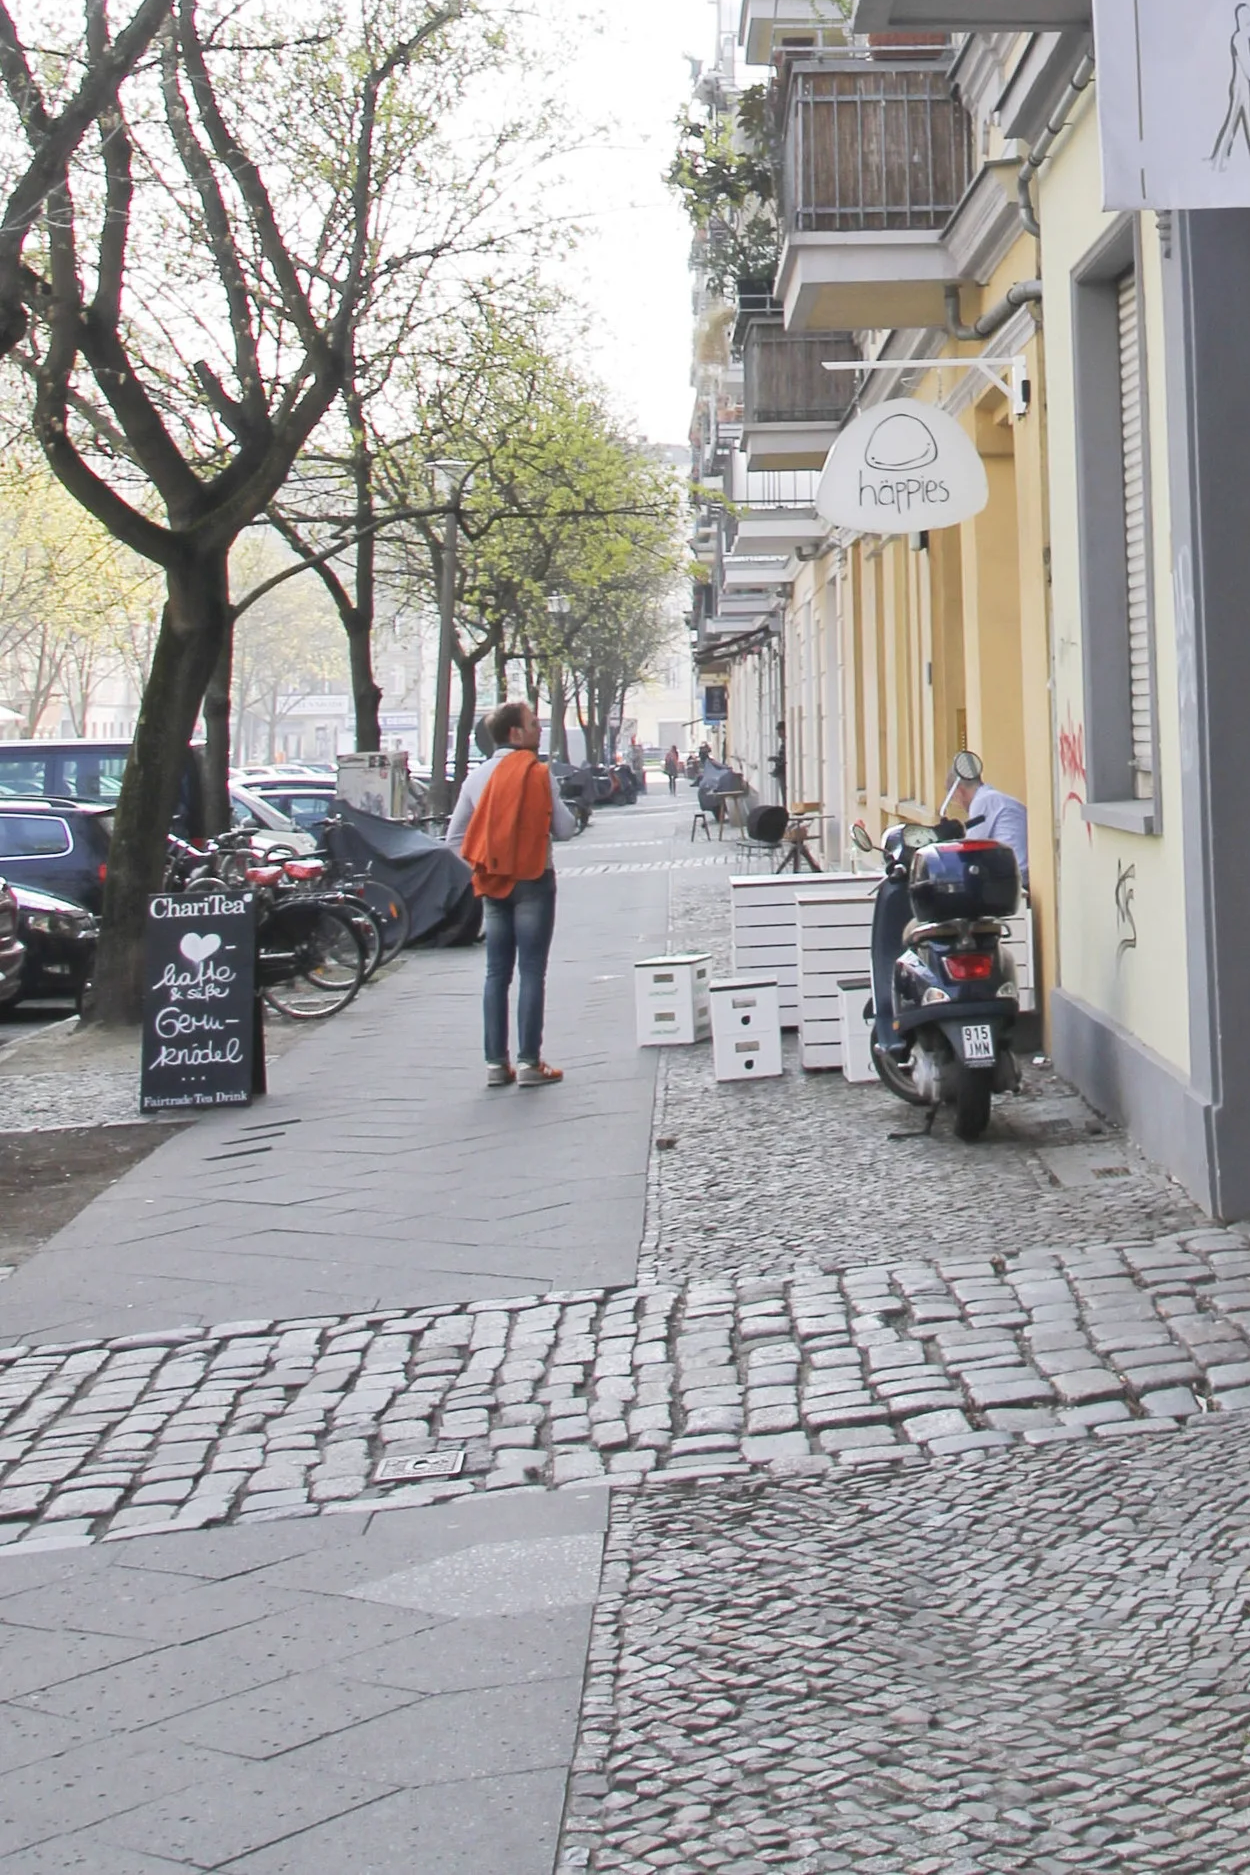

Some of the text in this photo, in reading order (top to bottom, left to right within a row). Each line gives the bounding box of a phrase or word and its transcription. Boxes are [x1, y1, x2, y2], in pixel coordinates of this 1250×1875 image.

[858, 469, 950, 514] häppies
[150, 894, 246, 919] ChariTea
[169, 987, 184, 1002] &
[964, 1026, 989, 1041] 915
[143, 1090, 248, 1108] Fairtrade Tea Drink
